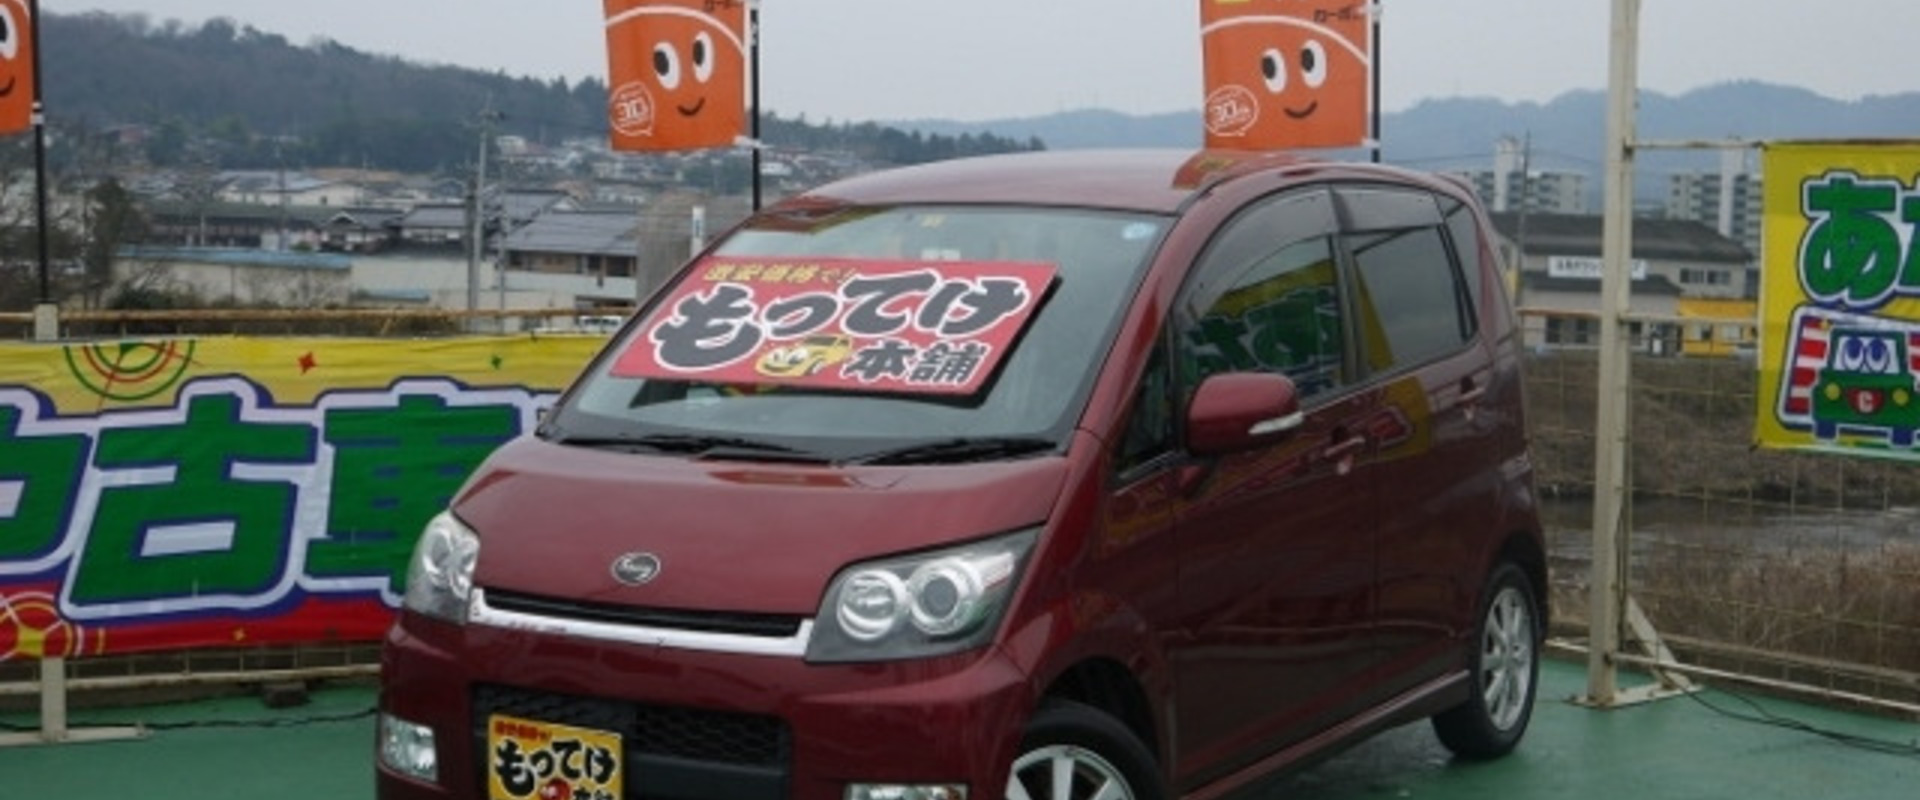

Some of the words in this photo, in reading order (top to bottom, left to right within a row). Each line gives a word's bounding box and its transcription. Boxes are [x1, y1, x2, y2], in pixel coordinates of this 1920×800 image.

[1807, 177, 1920, 300] あ
[650, 270, 1030, 370] もってけ
[840, 340, 991, 387] 本舗
[495, 739, 615, 797] もってけ
